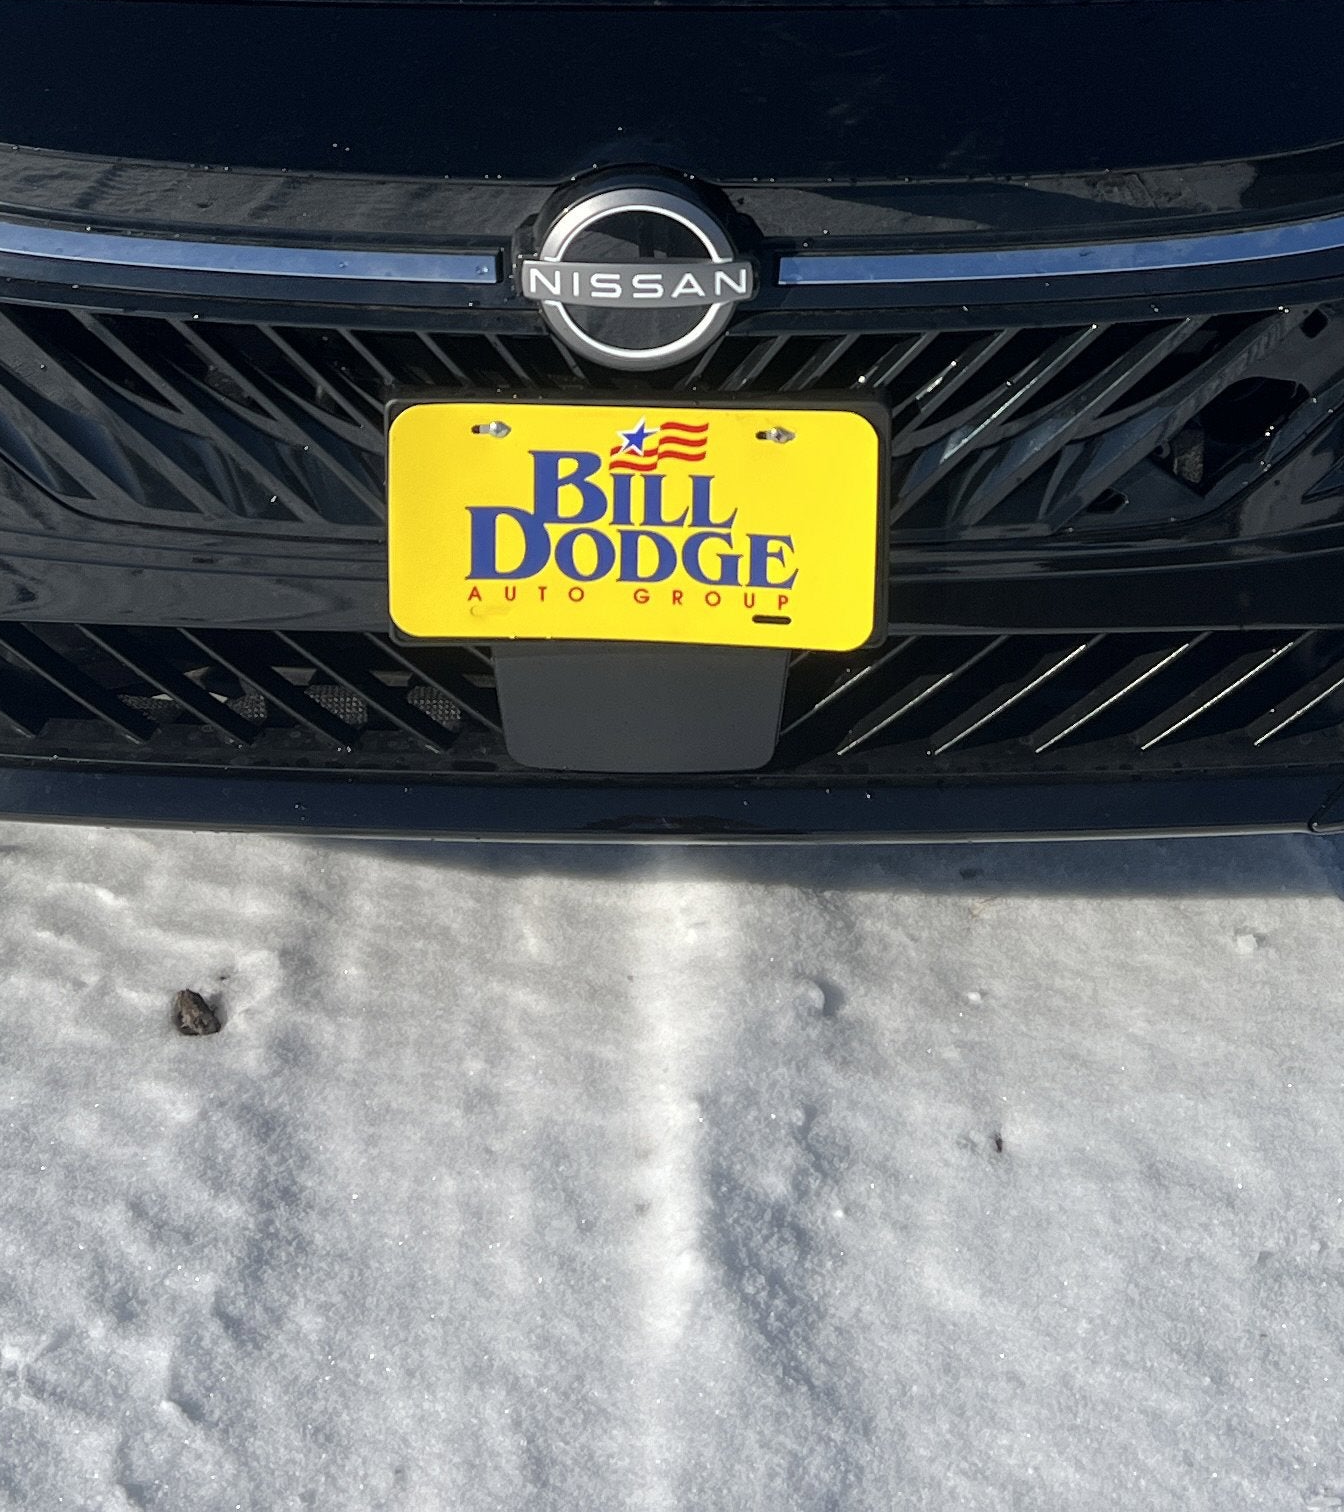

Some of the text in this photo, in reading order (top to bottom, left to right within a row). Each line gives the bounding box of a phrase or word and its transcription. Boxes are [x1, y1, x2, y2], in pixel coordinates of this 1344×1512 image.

[529, 268, 747, 299] NISSAN
[528, 449, 739, 529] BILL
[464, 505, 800, 590] DODGE
[467, 585, 790, 611] AUTO GROUP
